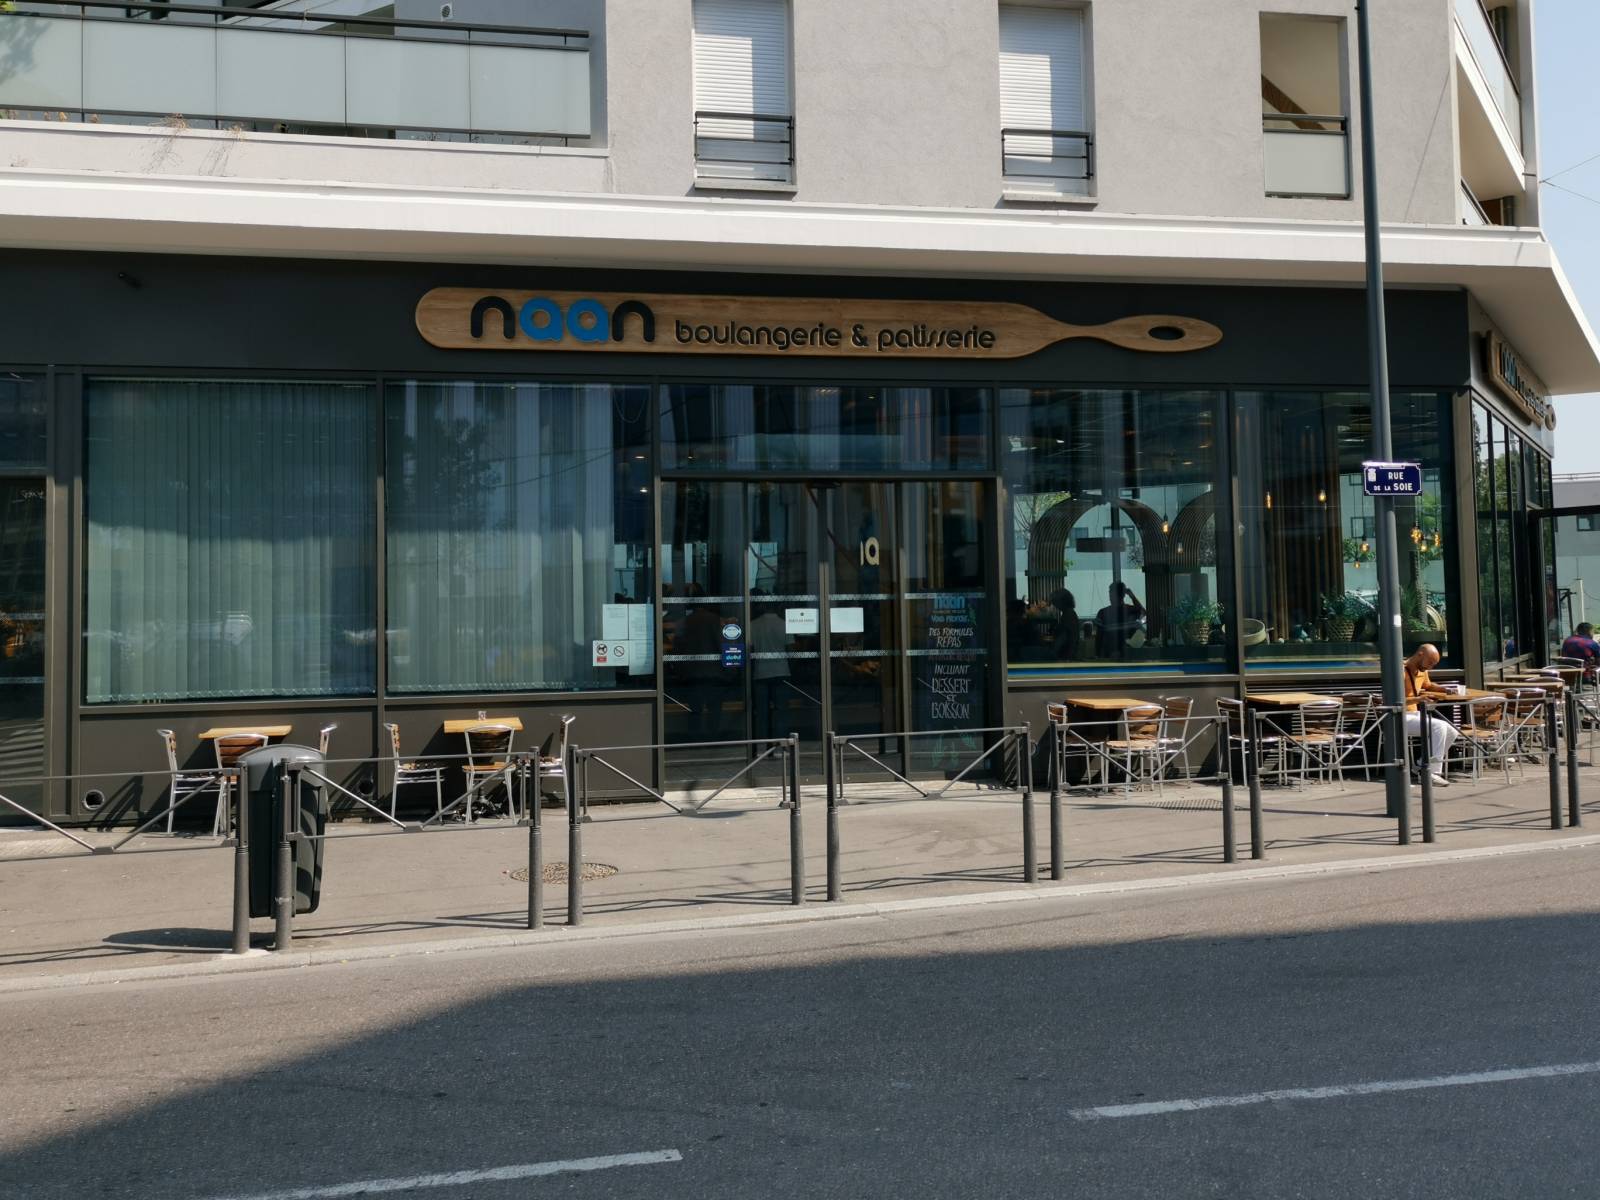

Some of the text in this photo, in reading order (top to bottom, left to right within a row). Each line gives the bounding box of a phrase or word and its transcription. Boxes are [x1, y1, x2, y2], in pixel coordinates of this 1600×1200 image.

[470, 296, 656, 343] naan
[675, 320, 996, 352] boulangerie & patisserie
[1388, 472, 1404, 480] RUE
[1393, 482, 1413, 491] SOIE
[932, 678, 971, 693] DESSERT
[932, 702, 970, 719] BOISSON
